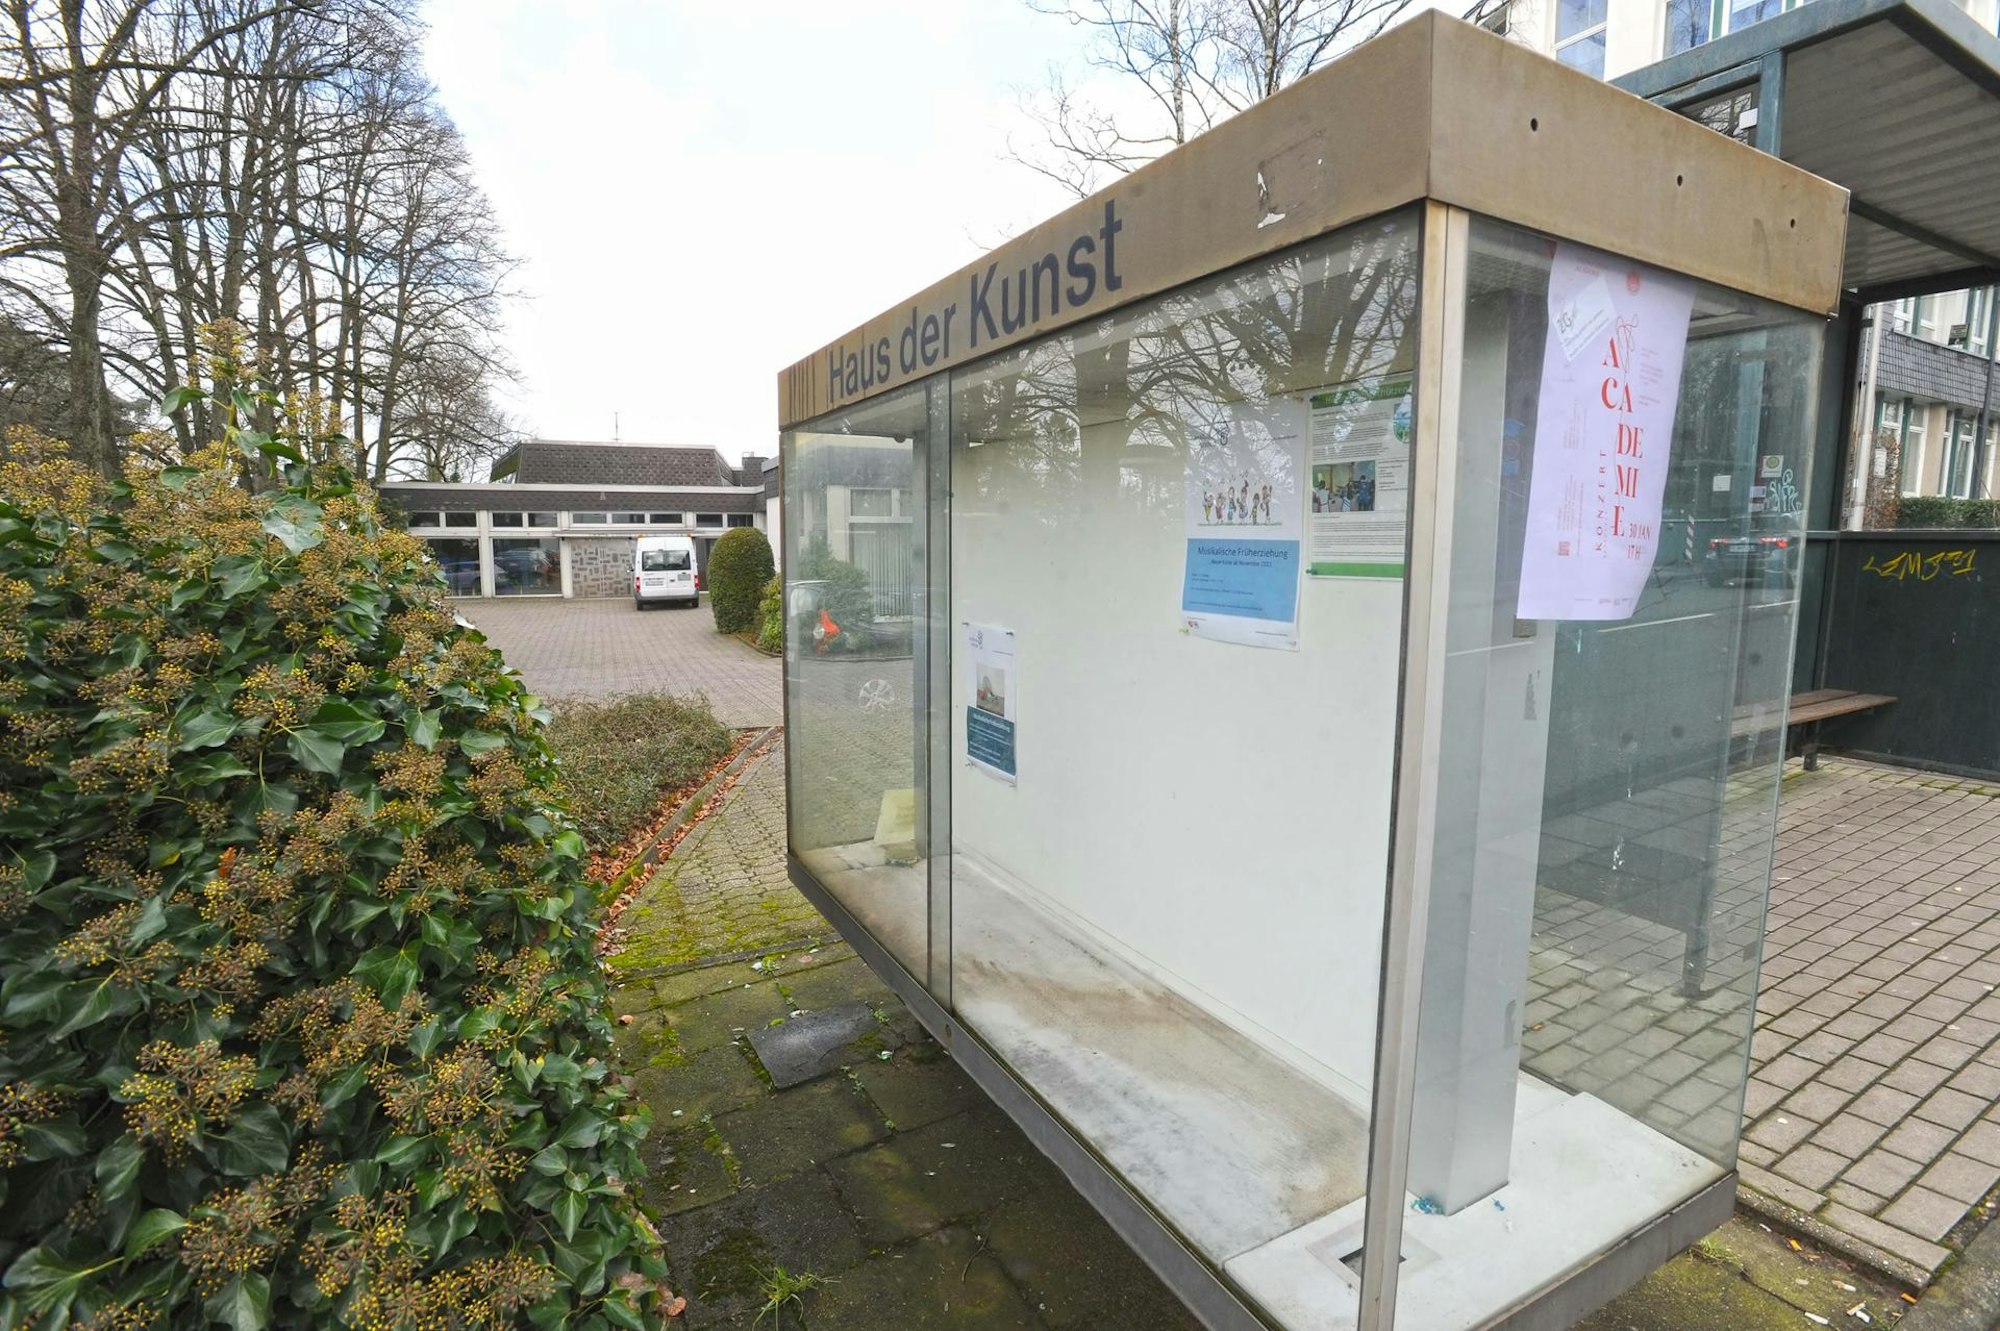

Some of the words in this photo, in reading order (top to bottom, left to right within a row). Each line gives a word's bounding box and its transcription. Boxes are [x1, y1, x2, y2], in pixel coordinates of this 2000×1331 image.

[828, 335, 890, 403] Haus
[899, 307, 956, 374] der
[970, 199, 1122, 348] Kunst
[1601, 376, 1633, 412] CA
[1617, 423, 1644, 459] DE
[1595, 450, 1607, 551] KONZERT
[1198, 545, 1236, 556] Musikalische
[1238, 547, 1289, 560] Früherziehung
